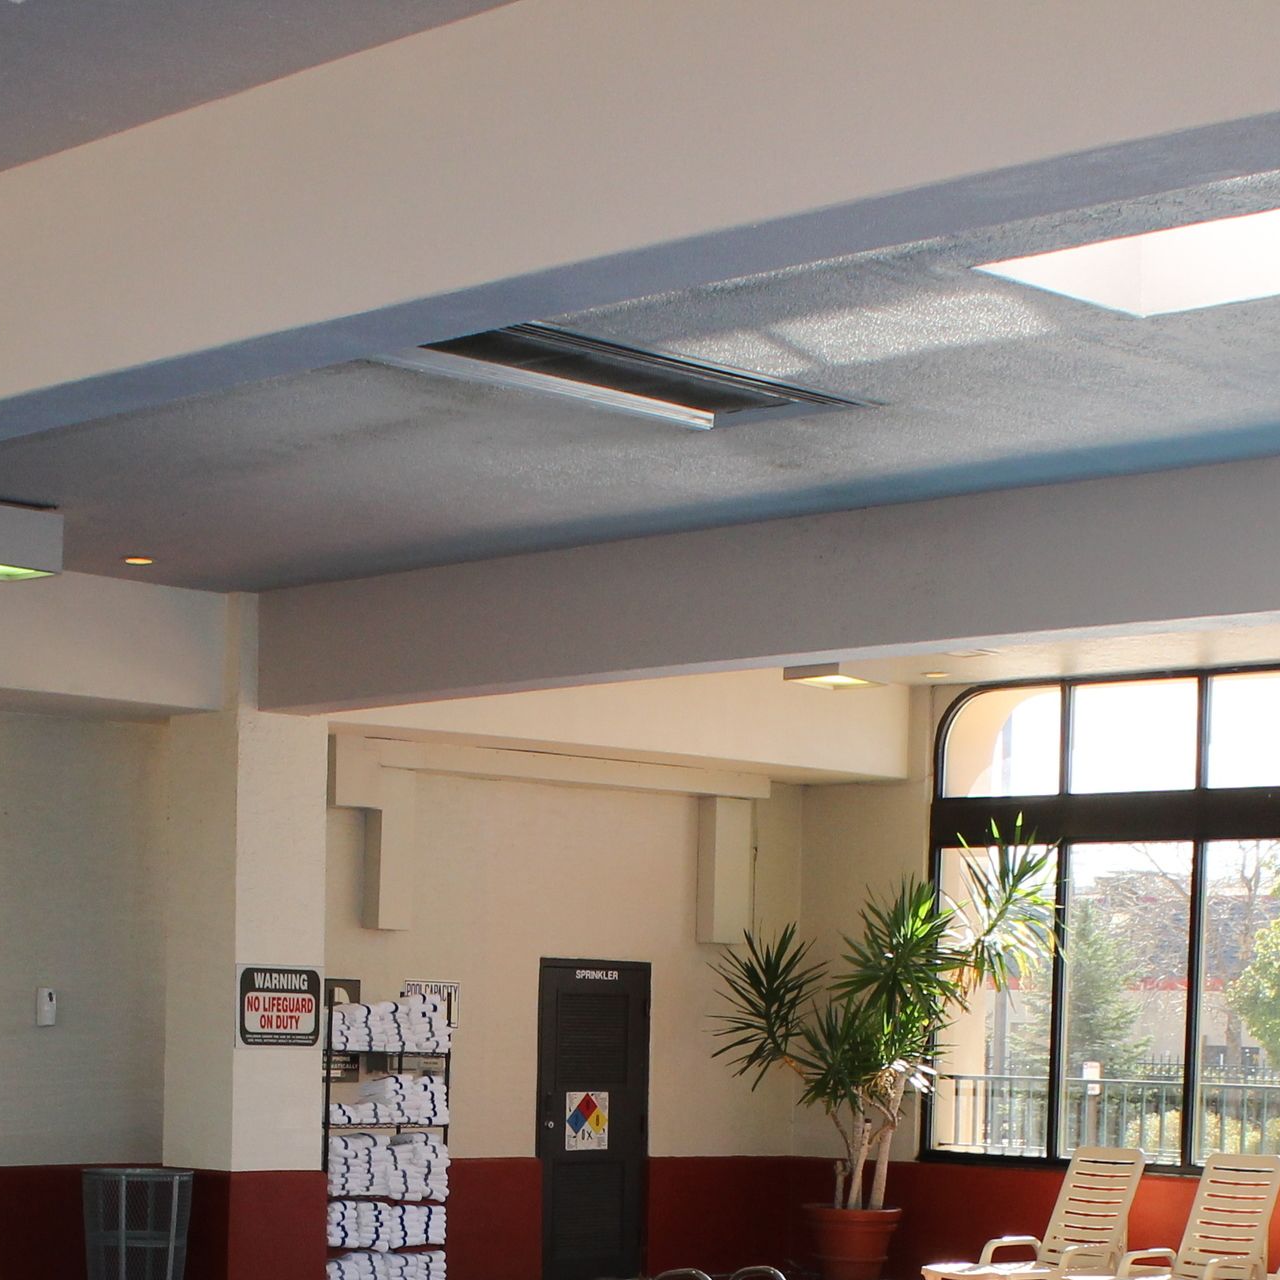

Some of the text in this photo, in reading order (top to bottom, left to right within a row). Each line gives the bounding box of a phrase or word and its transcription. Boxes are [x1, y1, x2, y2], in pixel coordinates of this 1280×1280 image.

[254, 972, 308, 991] WARNING
[575, 969, 619, 980] SPRINKLER
[246, 996, 313, 1014] NO LIFEGUARD
[259, 1014, 300, 1030] ON DUTY
